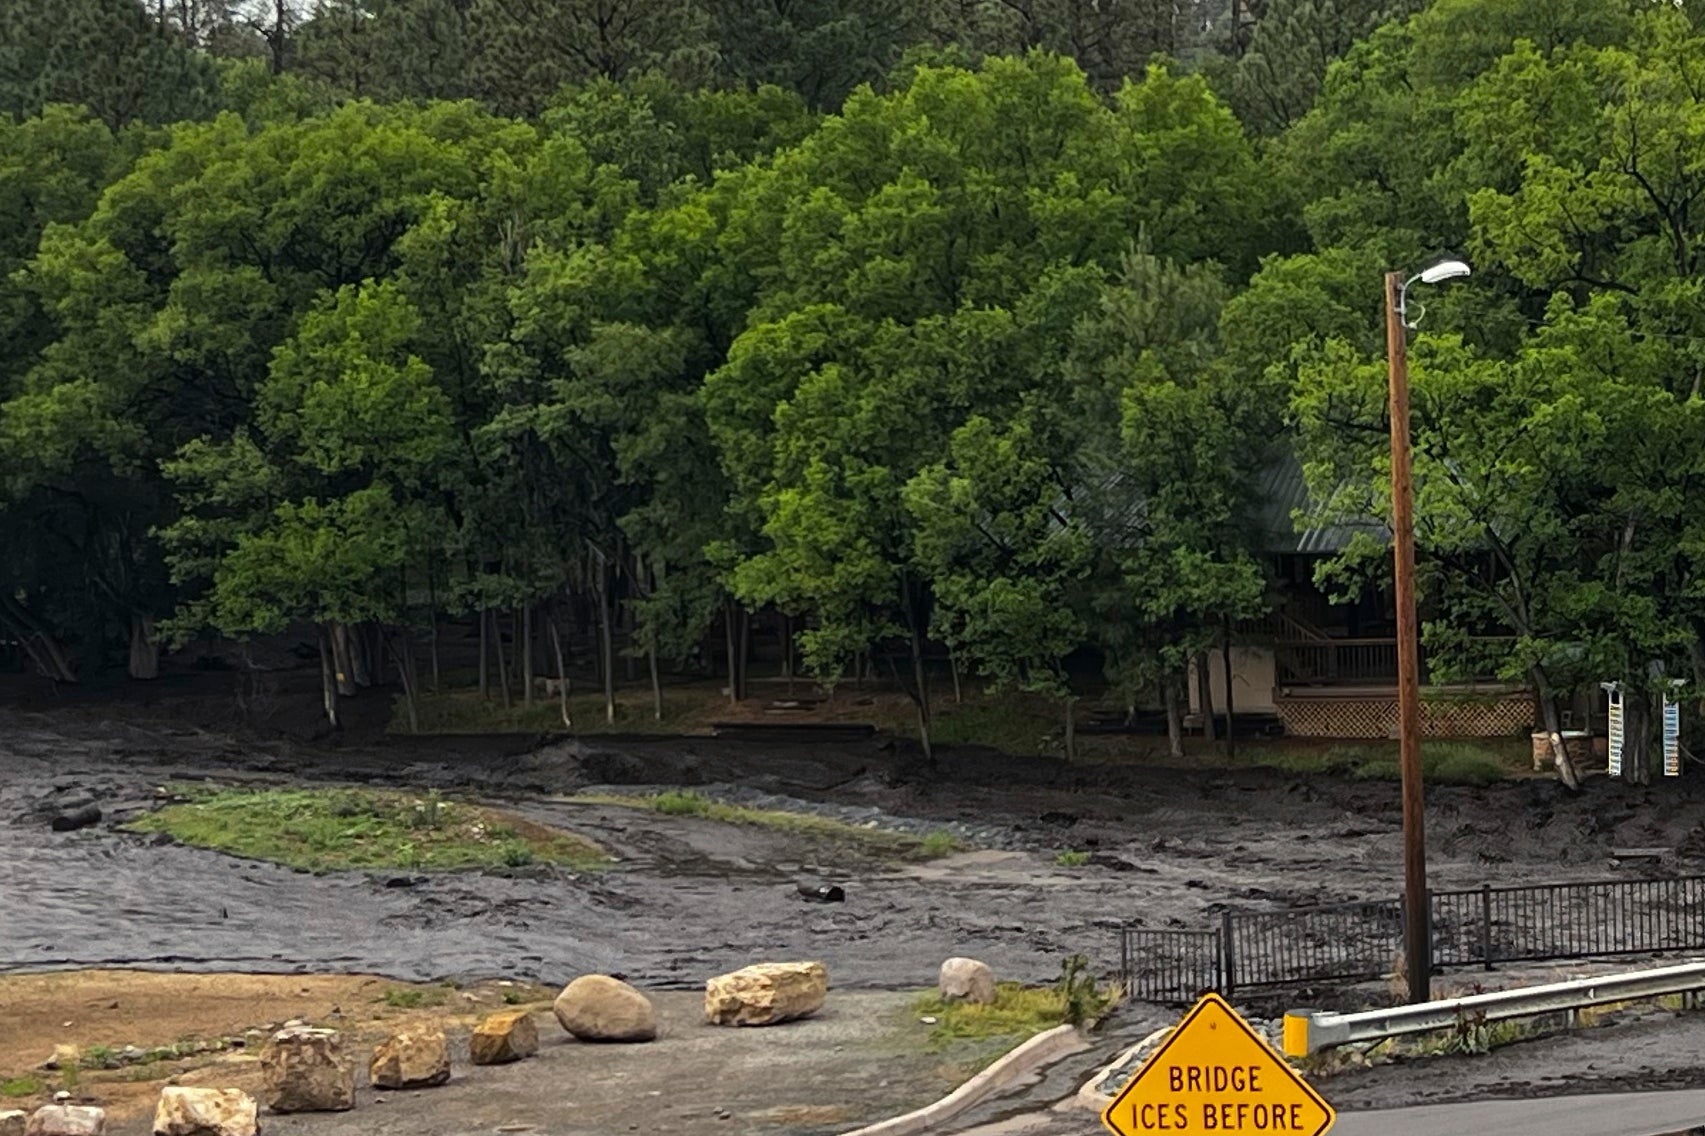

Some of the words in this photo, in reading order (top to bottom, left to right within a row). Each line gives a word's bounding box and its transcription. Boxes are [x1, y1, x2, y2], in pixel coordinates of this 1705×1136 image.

[1169, 1066, 1263, 1092] BRIDGE
[1132, 1103, 1187, 1129] ICES
[1203, 1103, 1304, 1130] BEFORE
